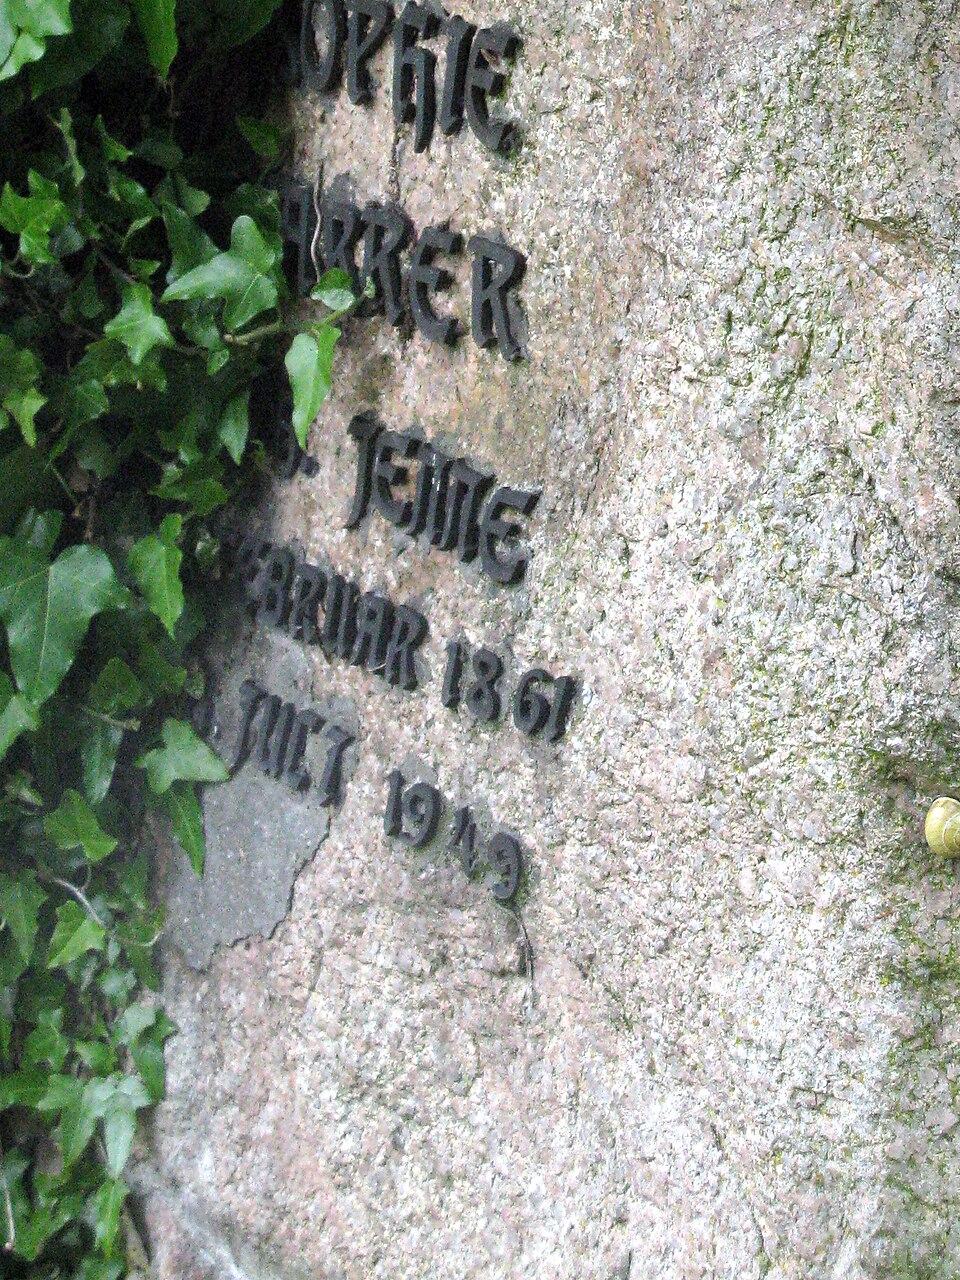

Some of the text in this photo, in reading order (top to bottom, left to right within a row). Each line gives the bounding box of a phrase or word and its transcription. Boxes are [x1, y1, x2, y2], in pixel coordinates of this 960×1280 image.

[278, 178, 530, 364] ARRER
[445, 640, 580, 744] 1861
[384, 770, 528, 904] 1949
